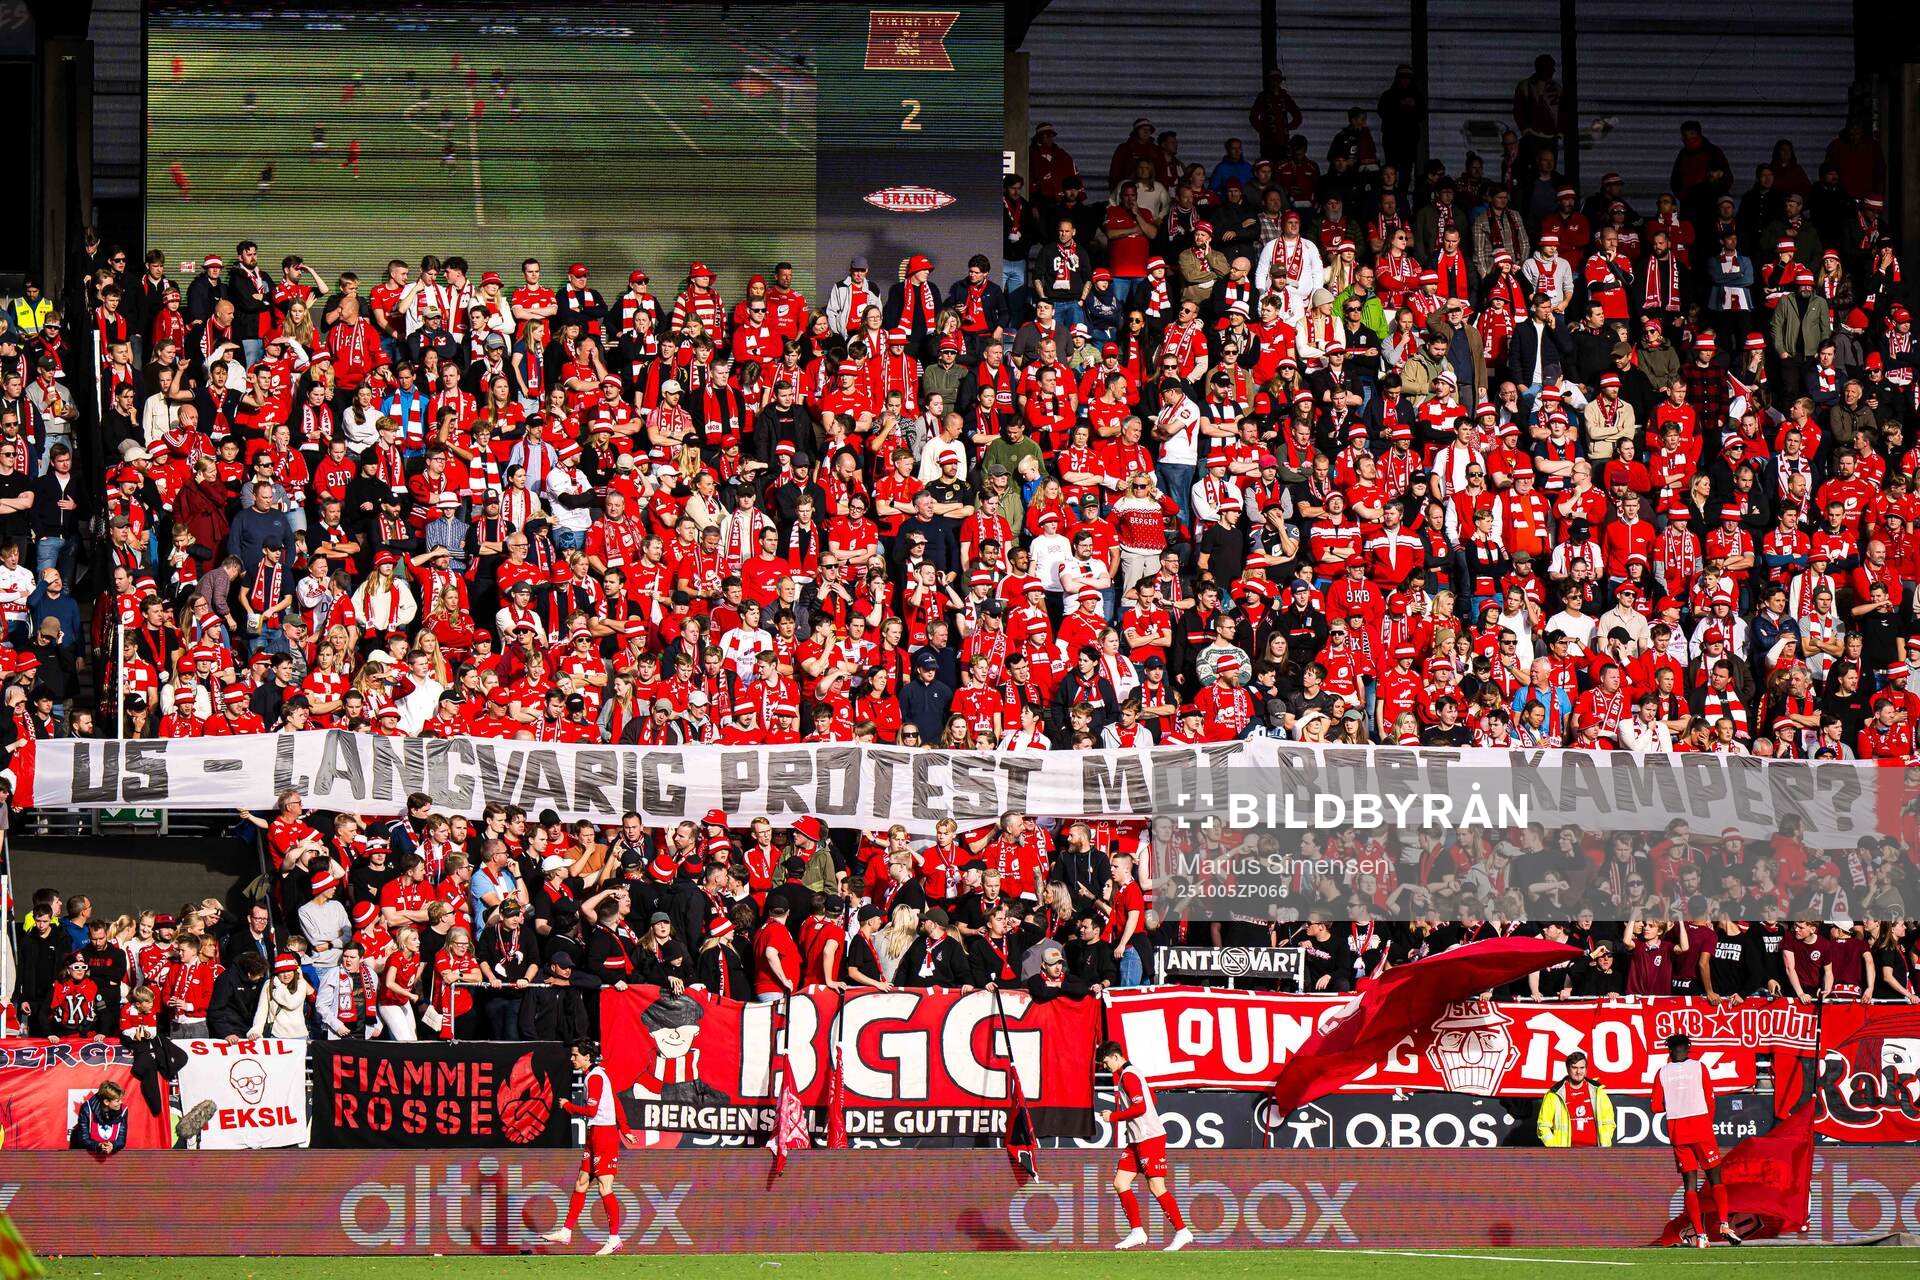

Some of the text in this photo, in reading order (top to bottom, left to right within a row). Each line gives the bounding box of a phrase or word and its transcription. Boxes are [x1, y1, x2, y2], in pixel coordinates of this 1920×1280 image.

[900, 99, 922, 130] 2
[881, 191, 938, 204] BRANN
[1130, 517, 1158, 526] BERGEN
[72, 741, 169, 804] US
[274, 730, 687, 817] LANGVARIG
[720, 746, 1045, 821] PROTEST
[1082, 738, 1245, 815] MOT
[1277, 746, 1462, 816] BORT
[1509, 750, 1863, 833] KAMPER?
[1166, 949, 1222, 972] ANTI
[1249, 951, 1299, 974] VAR!
[1714, 948, 1742, 961] OUTH
[1453, 1001, 1490, 1017] SKB
[1655, 1008, 1704, 1040] SKB
[0, 1043, 134, 1070] ERGE
[191, 1039, 294, 1062] STRIL
[738, 989, 1043, 1102] BGG
[332, 1053, 493, 1098] FIAMME
[333, 1092, 493, 1137] ROSSE
[644, 1103, 1007, 1135] BERGENS LDE GUTTER
[1737, 1119, 1757, 1138] på
[1345, 1112, 1498, 1149] OBOS
[338, 1156, 693, 1248] altibox
